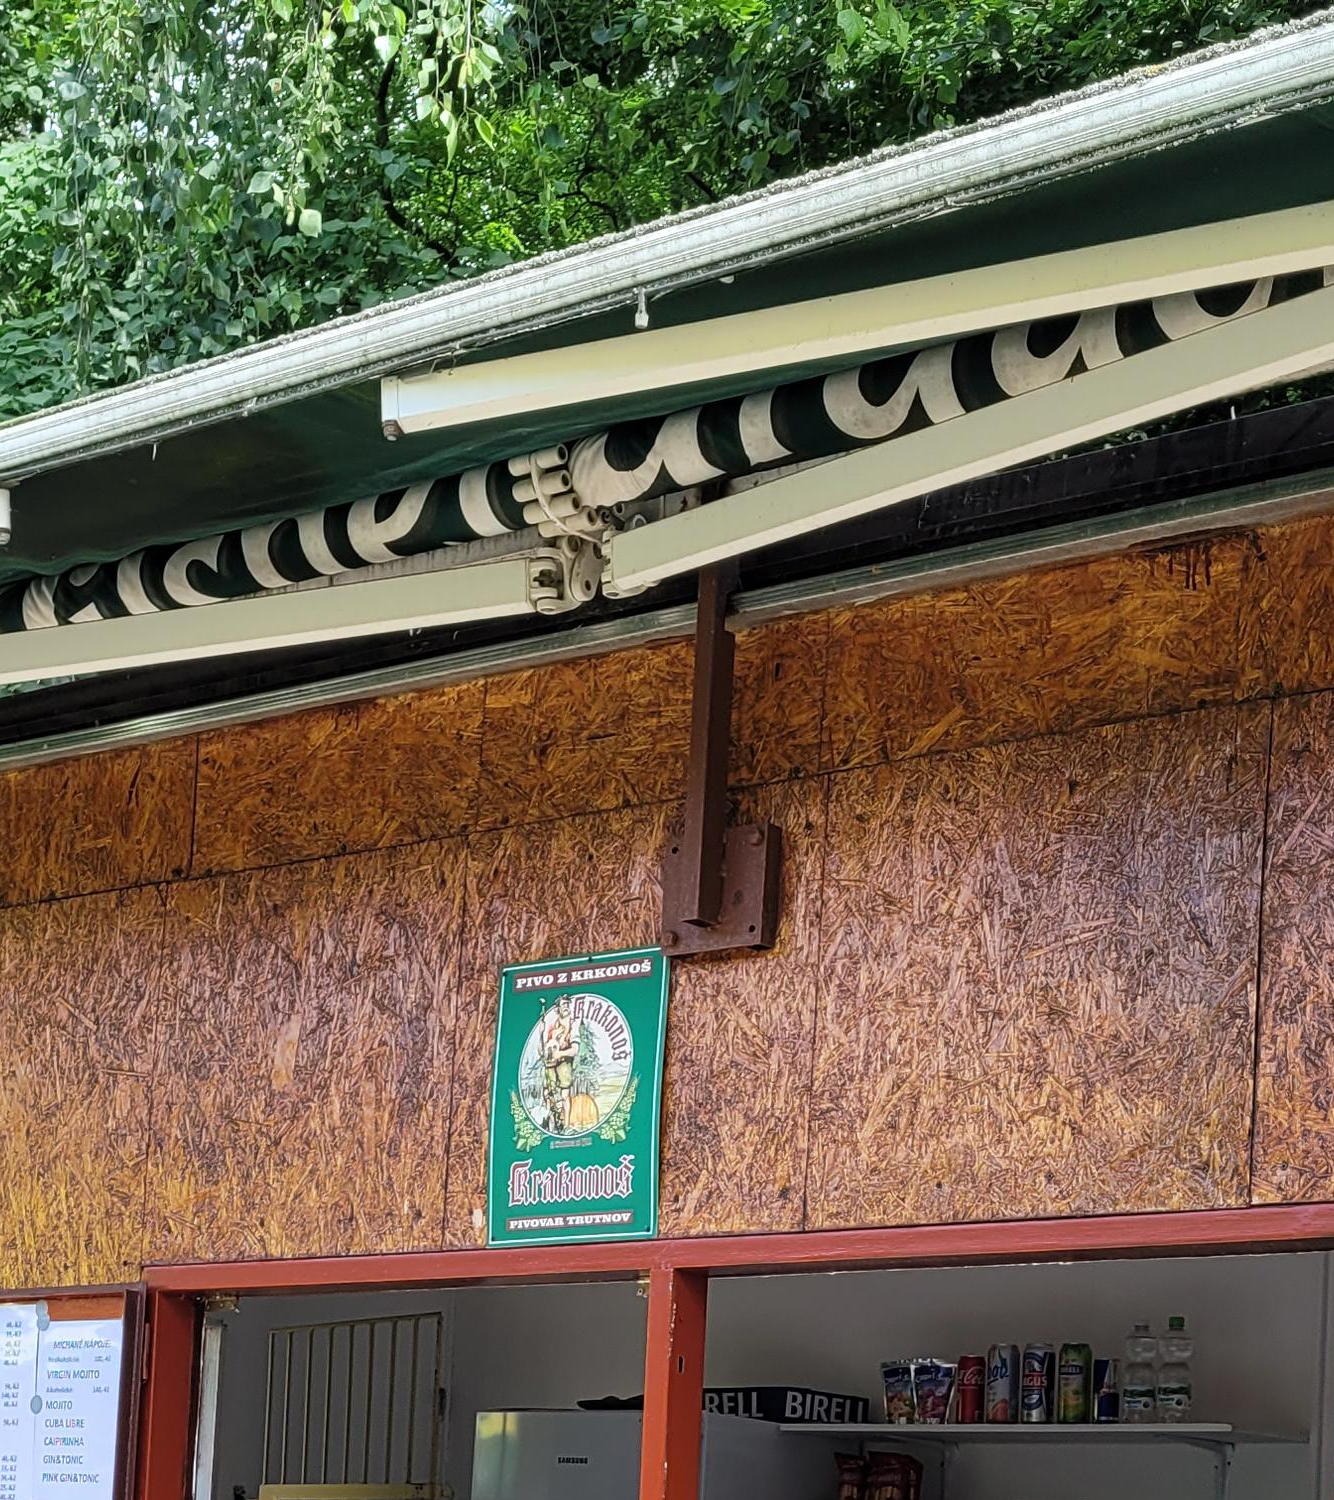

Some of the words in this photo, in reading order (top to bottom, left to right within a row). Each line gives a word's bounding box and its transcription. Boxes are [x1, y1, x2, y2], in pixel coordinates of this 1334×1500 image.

[516, 974, 554, 989] PIVO
[558, 973, 568, 984] Z
[571, 960, 651, 982] KRKONOŠ
[573, 995, 632, 1062] Krakonoš
[509, 1155, 635, 1207] Krakonoš
[509, 1217, 563, 1229] PIVOVAR
[566, 1213, 630, 1225] TRUTNOV
[47, 1370, 71, 1380] VIRGIN
[73, 1370, 100, 1379] MOJITO
[1024, 1374, 1047, 1386] GUS
[46, 1401, 72, 1410] MOJITO
[705, 1392, 763, 1417] RELL
[45, 1419, 64, 1428] CUBA
[66, 1419, 84, 1428] LIBRE
[44, 1437, 84, 1446] CAIPIRINHA
[43, 1455, 83, 1464] GIN&TONIC
[558, 1456, 588, 1464] SAMSUNG
[42, 1473, 58, 1483] PINK
[60, 1474, 99, 1483] GIN&TONIC
